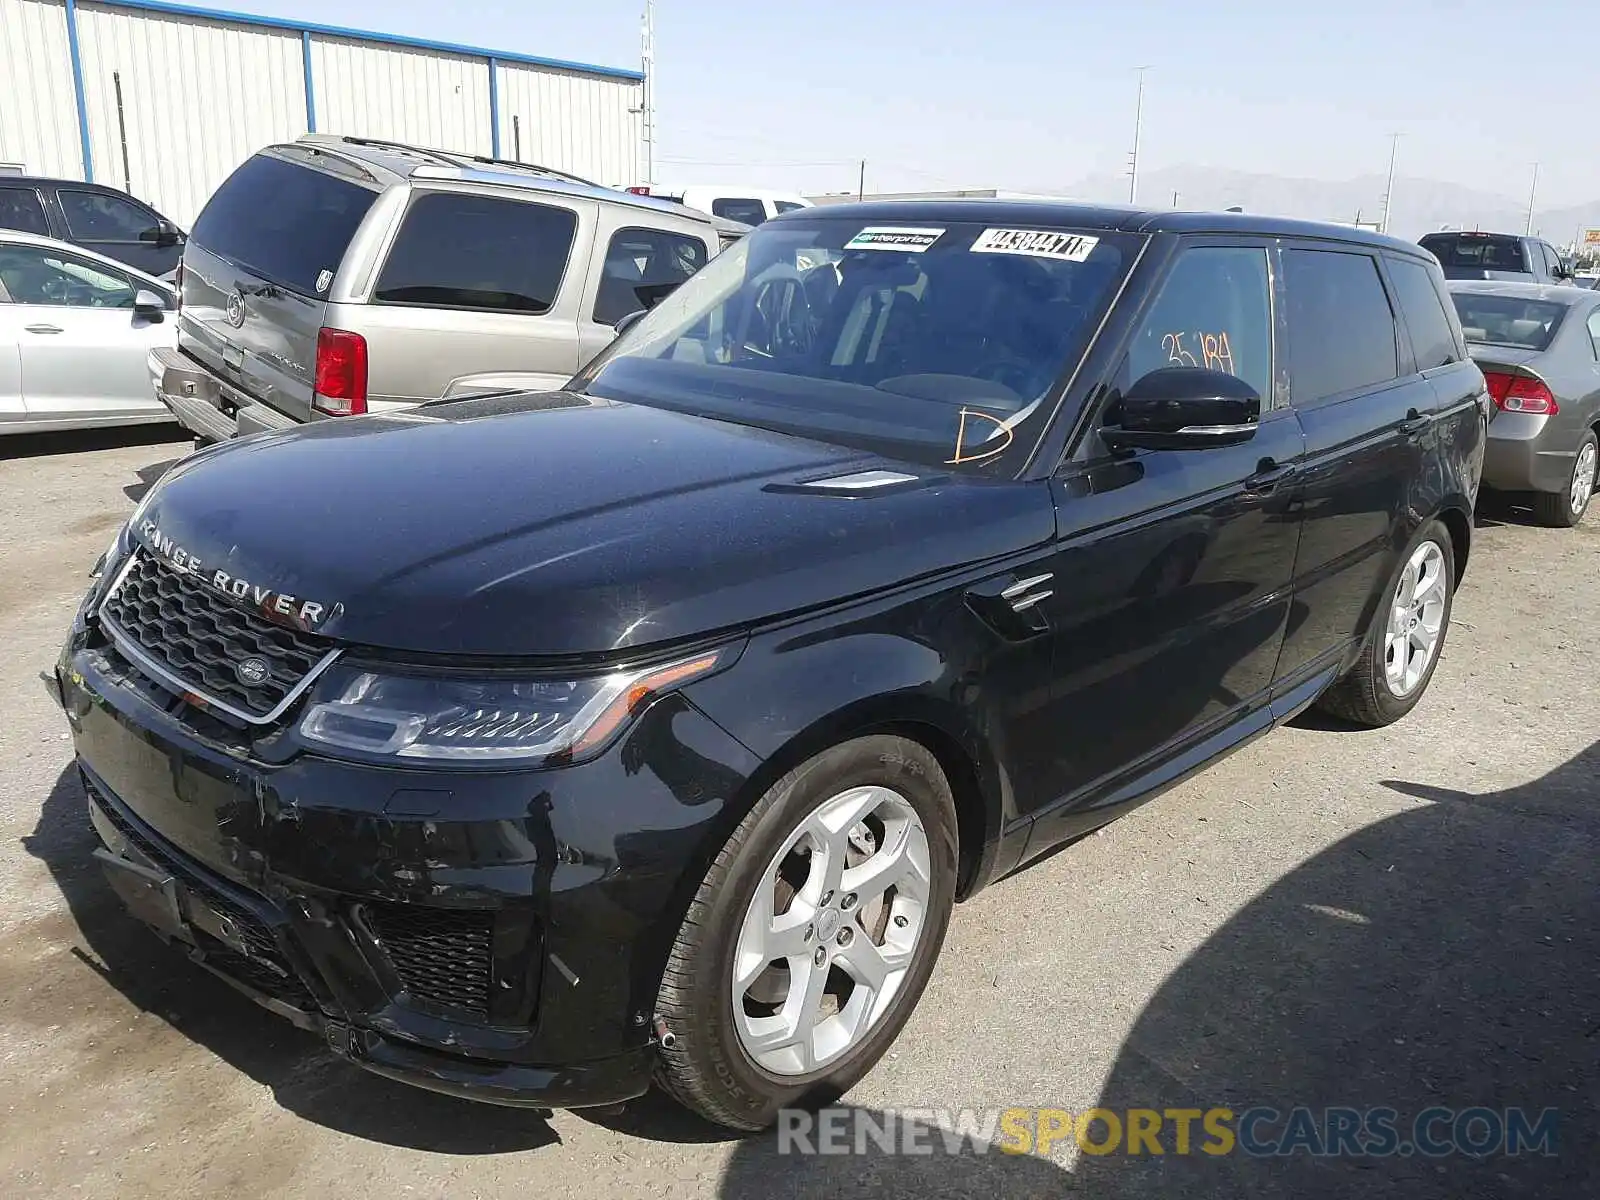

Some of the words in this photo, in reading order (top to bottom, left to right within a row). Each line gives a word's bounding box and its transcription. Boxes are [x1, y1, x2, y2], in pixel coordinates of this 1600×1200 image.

[856, 232, 934, 245] enterprise
[985, 230, 1083, 256] 44384471
[944, 406, 1013, 465] D
[140, 518, 202, 572] RANGE
[213, 568, 324, 623] ROVER
